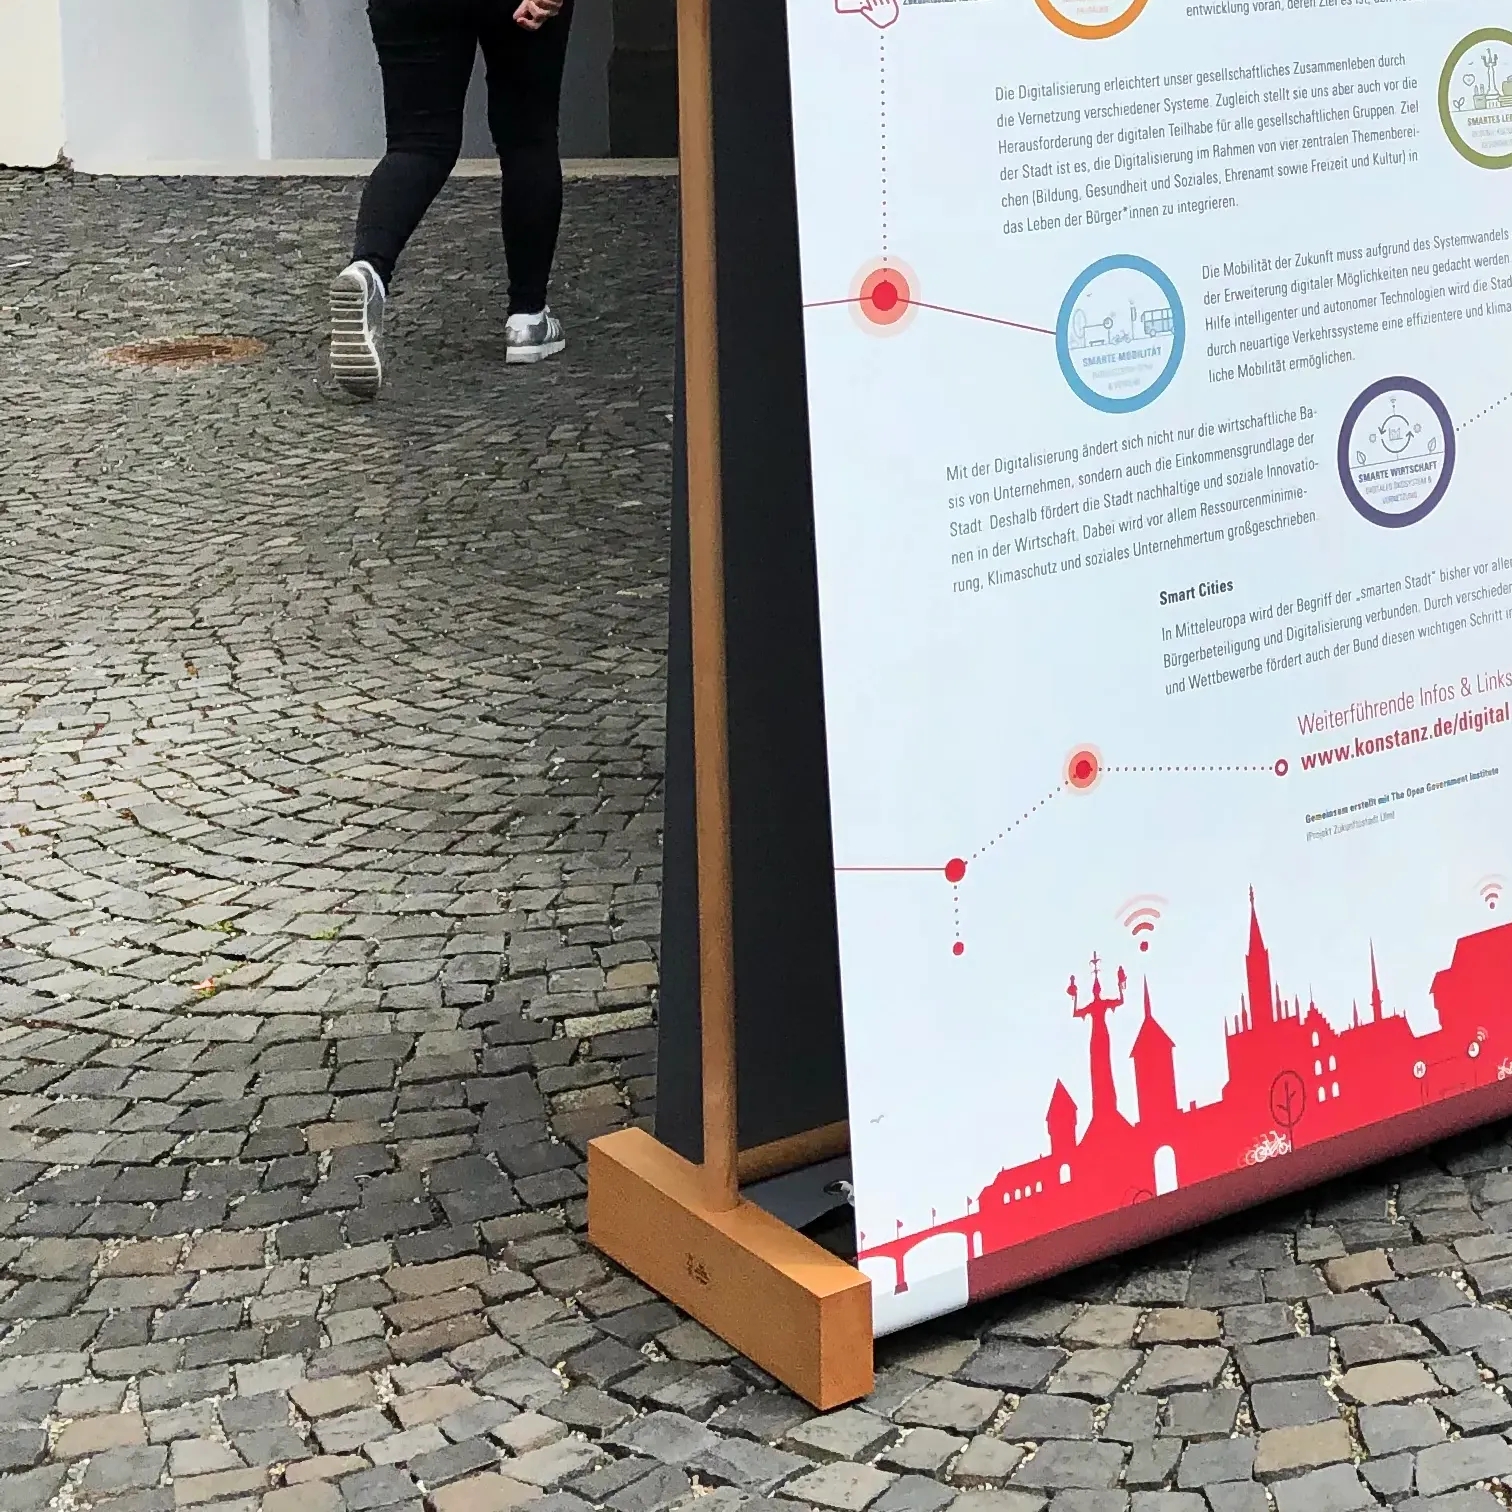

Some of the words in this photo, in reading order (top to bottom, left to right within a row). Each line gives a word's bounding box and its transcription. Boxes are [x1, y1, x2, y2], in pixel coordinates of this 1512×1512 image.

[1467, 114, 1501, 127] SMARTES
[1003, 219, 1024, 235] das
[1026, 215, 1061, 232] Leben
[1064, 213, 1083, 227] der
[1162, 204, 1174, 216] zu
[1177, 195, 1239, 215] integrieren.
[1082, 353, 1116, 368] SMARTE
[1118, 346, 1162, 362] MOBILITÄT
[1208, 367, 1235, 383] liche
[1237, 359, 1287, 379] Mobilität
[1289, 349, 1356, 371] ermöglichen.
[1358, 469, 1389, 484] SMARTE
[1389, 460, 1438, 477] WIRTSCHAFT
[1159, 586, 1196, 606] Smart
[1198, 579, 1234, 598] Cities
[1297, 691, 1415, 736] Weiterführende
[1419, 683, 1455, 707] Infos
[1460, 677, 1472, 697] &
[1476, 669, 1512, 694] Links
[1300, 701, 1510, 771] www.konstanz.de/digital
